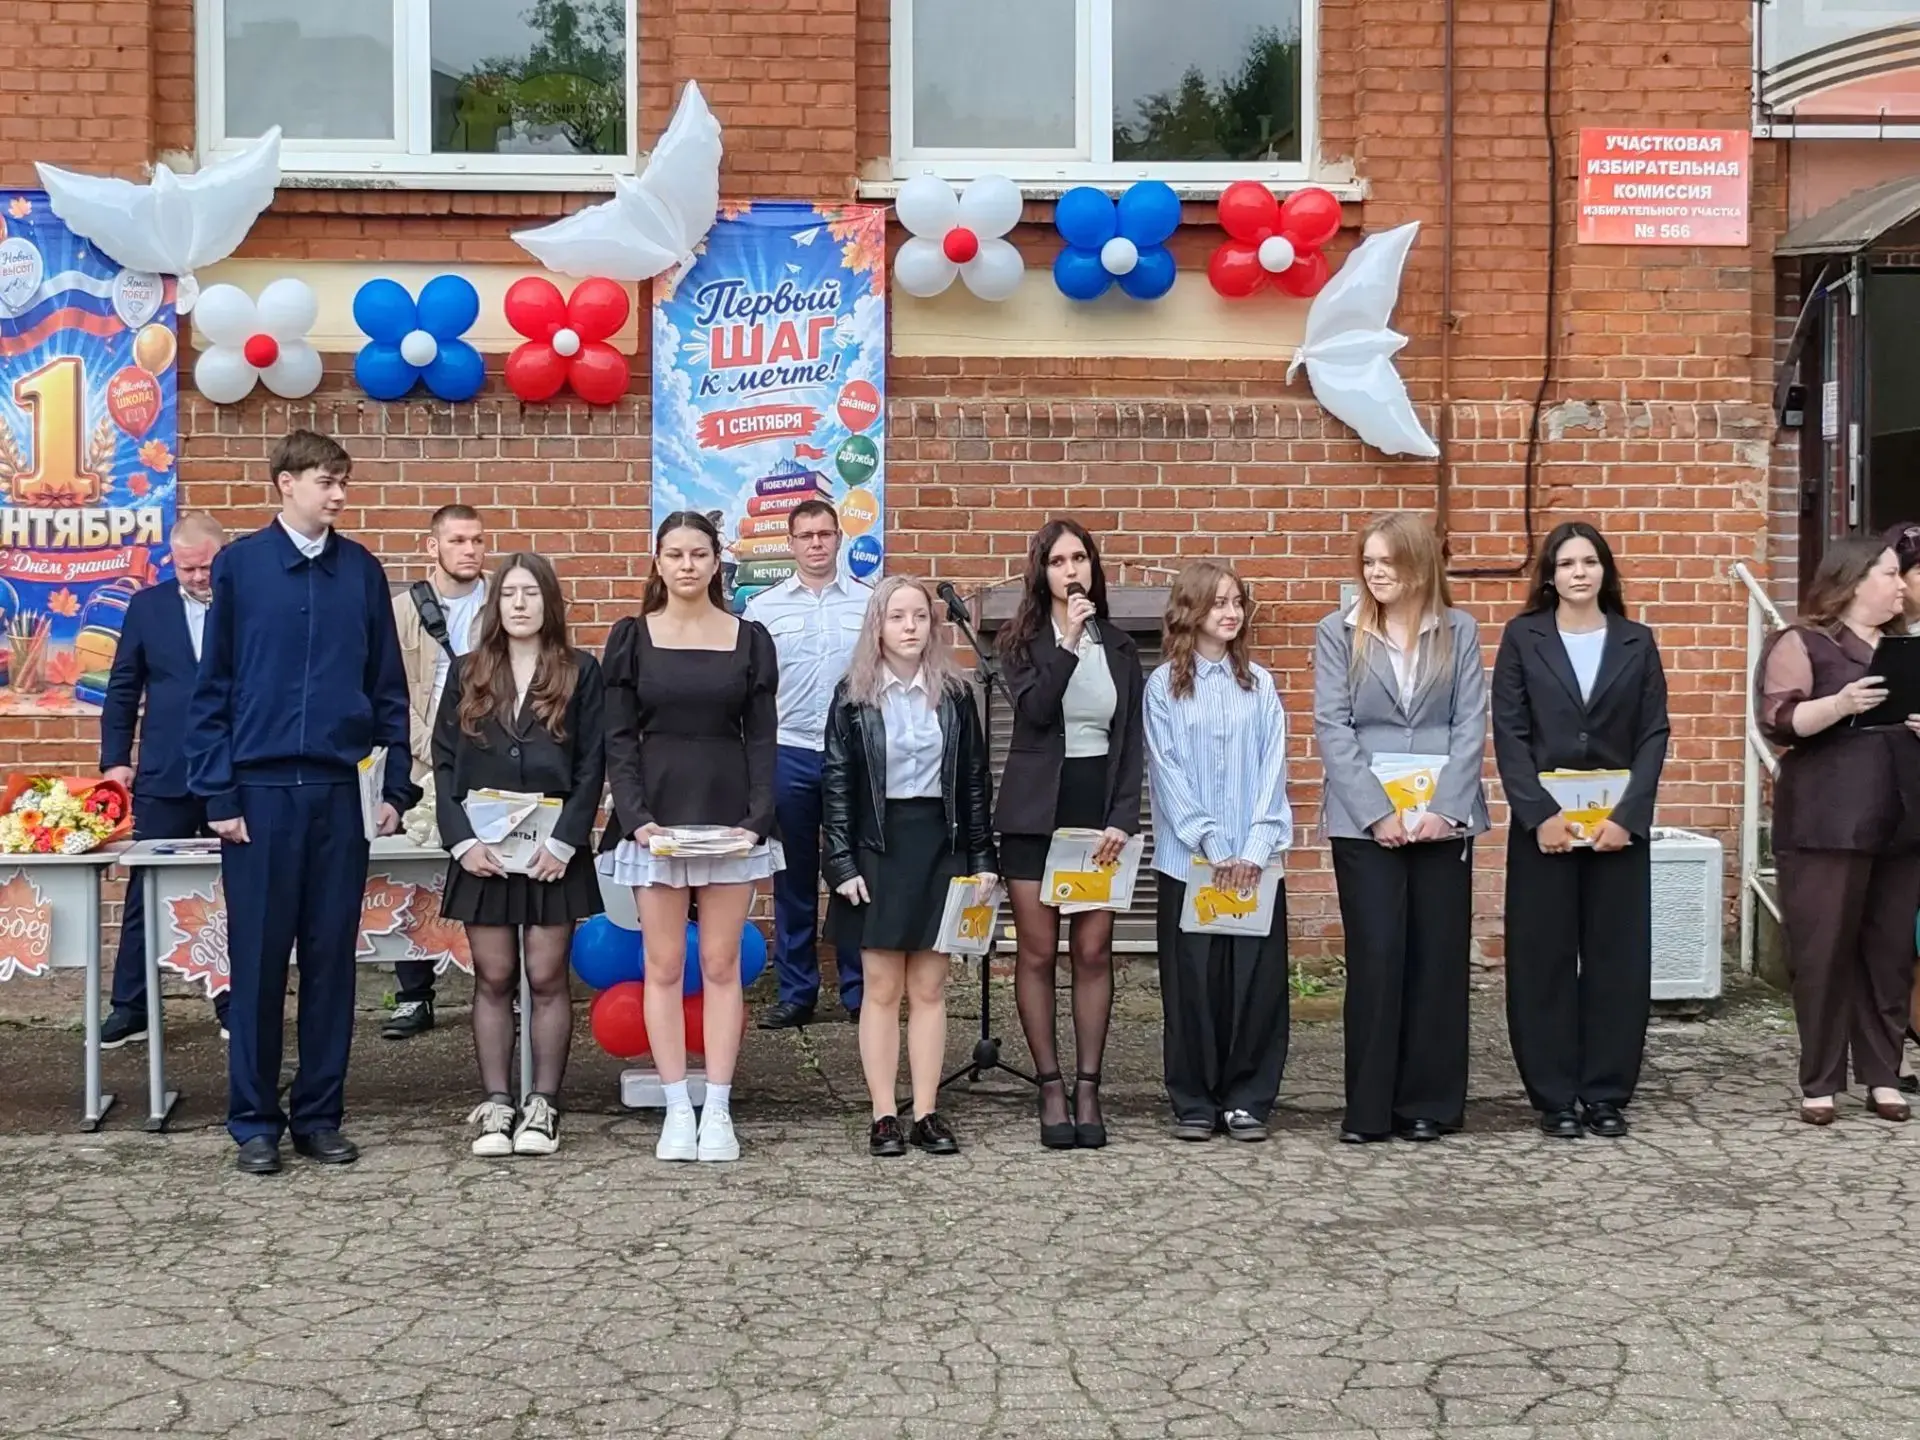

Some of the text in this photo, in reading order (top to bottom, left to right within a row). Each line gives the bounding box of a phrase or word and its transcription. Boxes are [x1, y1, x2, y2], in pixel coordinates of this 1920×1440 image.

[1606, 136, 1722, 152] УЧАСТКОВАЯ
[1587, 160, 1739, 176] ИЗБИРАТЕЛЬНАЯ
[1613, 184, 1712, 199] КОМИССИЯ
[1583, 205, 1742, 217] ИЗБИРАТЕЛЬНОГО УЧАСТКА
[1634, 224, 1691, 238] № 566
[696, 279, 840, 327] Первый
[710, 316, 835, 370] ШАГ
[727, 353, 841, 394] мечте!
[840, 397, 877, 413] знания
[13, 355, 101, 502] 1
[716, 412, 803, 437] 1 СЕНТЯБРЯ
[838, 449, 875, 467] дружба
[763, 477, 806, 491] ПОБЕЖДАЮ
[0, 506, 163, 549] НТЯБРЯ
[754, 519, 789, 533] ДЕЙСТВУ
[10, 552, 64, 576] Днём
[63, 549, 133, 581] знаний!
[852, 549, 878, 565] цели
[753, 568, 792, 579] МЕЧТАЮ
